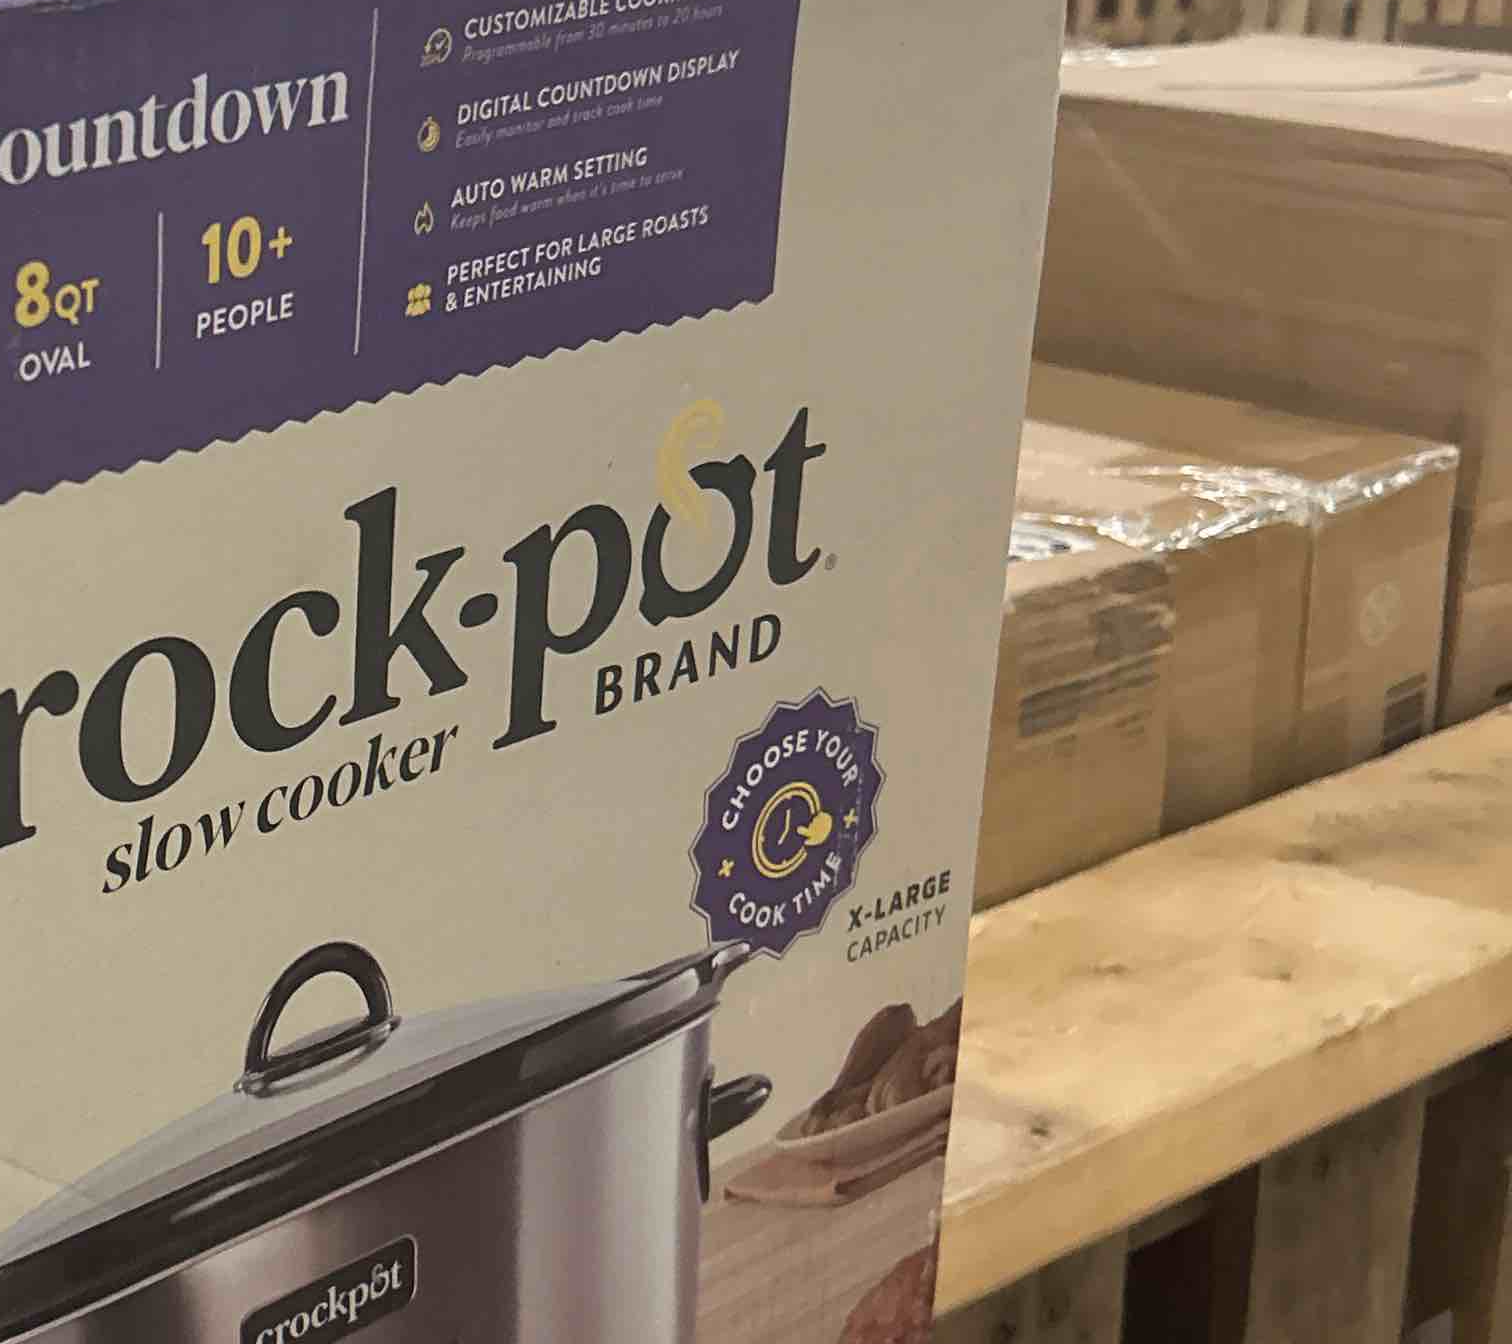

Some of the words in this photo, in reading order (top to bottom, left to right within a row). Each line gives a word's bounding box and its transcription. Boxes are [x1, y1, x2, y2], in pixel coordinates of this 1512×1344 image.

[457, 90, 533, 126] DIGITAL
[537, 64, 663, 109] COUNTDOWN
[667, 49, 741, 83] DISPLAY
[451, 178, 505, 208] AUTO
[511, 164, 568, 195] WARM
[574, 146, 648, 180] SETTING
[201, 215, 294, 284] 10+
[447, 247, 530, 287] PERFECT
[535, 237, 573, 266] FOR
[578, 222, 637, 254] LARGE
[641, 205, 710, 240] ROASTS
[196, 293, 294, 339] PEOPLE
[445, 291, 458, 312] &
[463, 256, 602, 310] ENTERTAINING
[18, 342, 92, 382] OVAL
[594, 610, 784, 719] BRAND
[102, 801, 245, 894] slow
[256, 720, 460, 839] cooker
[722, 729, 809, 830] CHOOSE
[814, 729, 860, 787] YOUR
[729, 891, 786, 928] COOK
[792, 851, 842, 915] TIME
[848, 870, 951, 932] X-LARGE
[847, 905, 946, 962] CAPACITY
